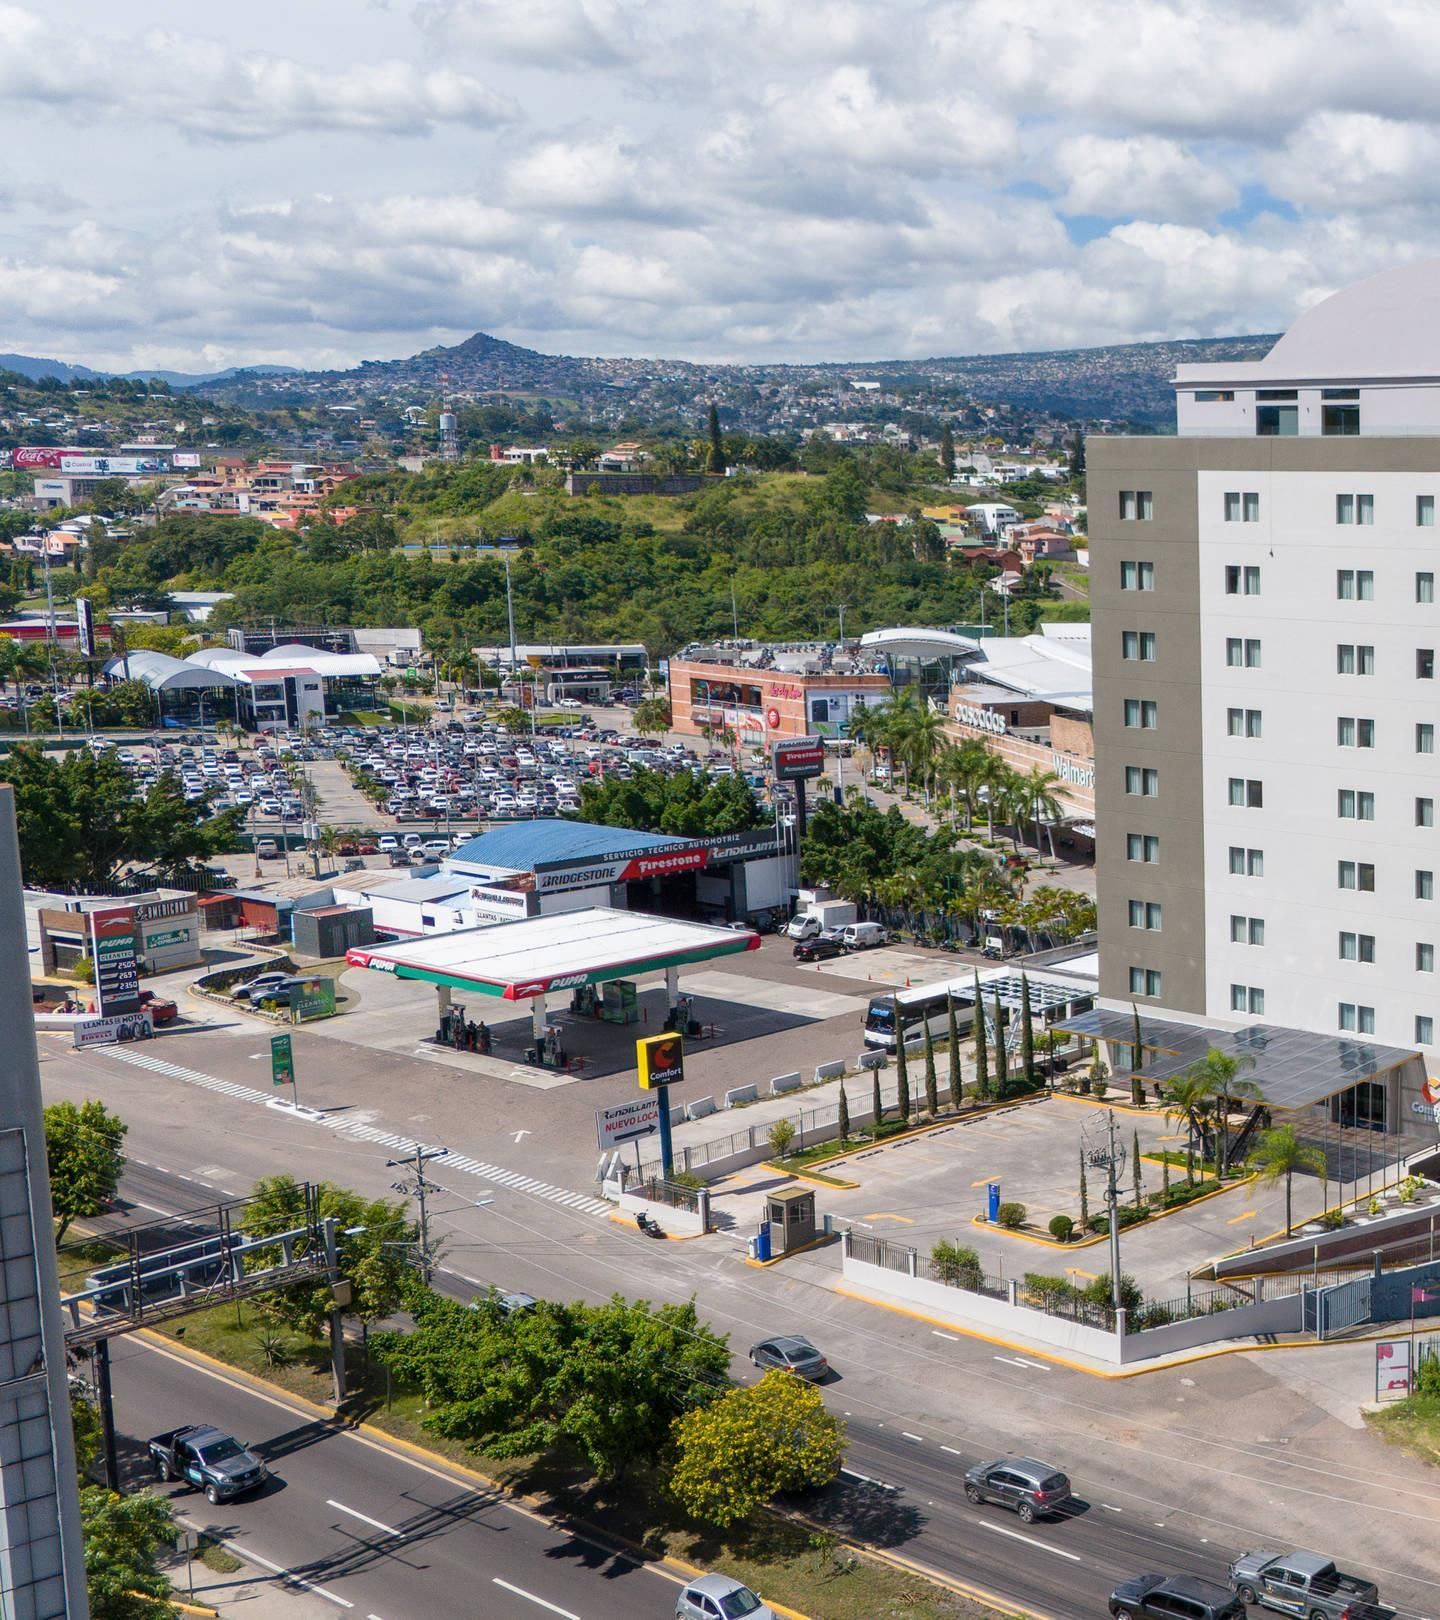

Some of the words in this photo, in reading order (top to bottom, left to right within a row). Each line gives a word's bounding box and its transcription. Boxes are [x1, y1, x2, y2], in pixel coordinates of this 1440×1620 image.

[955, 703, 1007, 735] cascadas
[785, 751, 822, 760] Firestone
[1053, 750, 1096, 790] Walmart
[603, 849, 644, 861] SERVICIO
[688, 834, 740, 849] AUTOMOTRIZ
[638, 855, 701, 873] Firestone
[542, 866, 617, 888] BRIDGESTONE
[98, 937, 134, 949] PUMA
[369, 958, 396, 971] PUMA
[549, 973, 588, 990] PUMA
[82, 1017, 114, 1029] LLANTAS
[121, 1013, 144, 1023] MOTO
[650, 1067, 682, 1081] Comfort
[605, 1116, 636, 1133] NUEVO
[636, 1110, 658, 1123] LOCA
